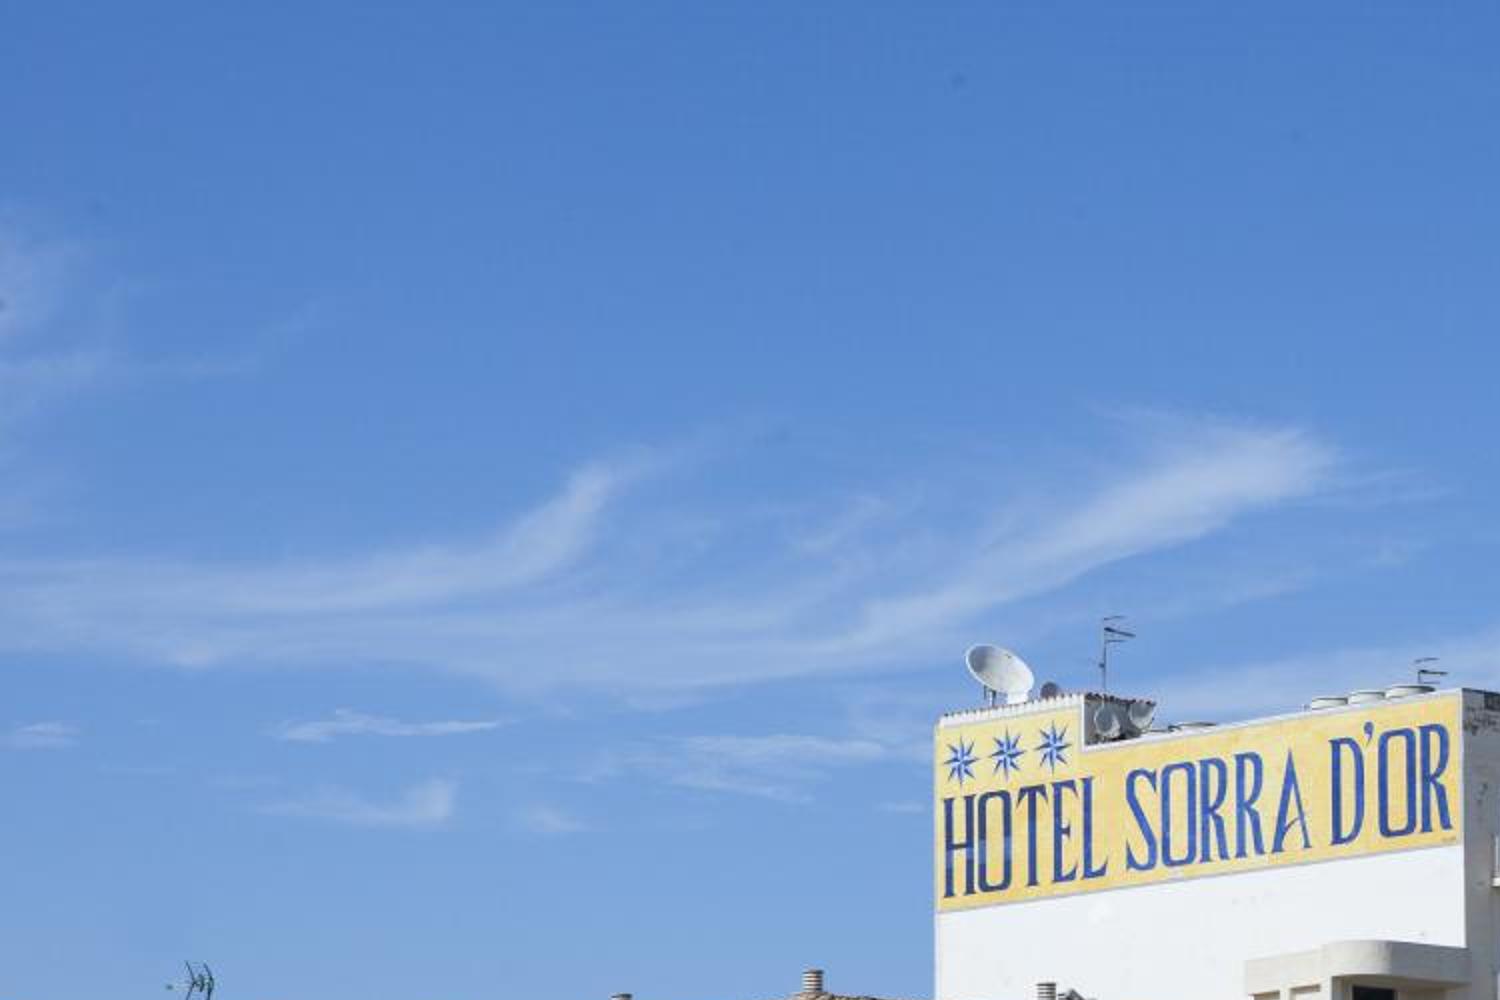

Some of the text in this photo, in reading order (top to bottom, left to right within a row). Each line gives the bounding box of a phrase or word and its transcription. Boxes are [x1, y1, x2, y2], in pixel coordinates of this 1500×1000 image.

[943, 721, 1453, 898] HOTEL SORRA D'OR
